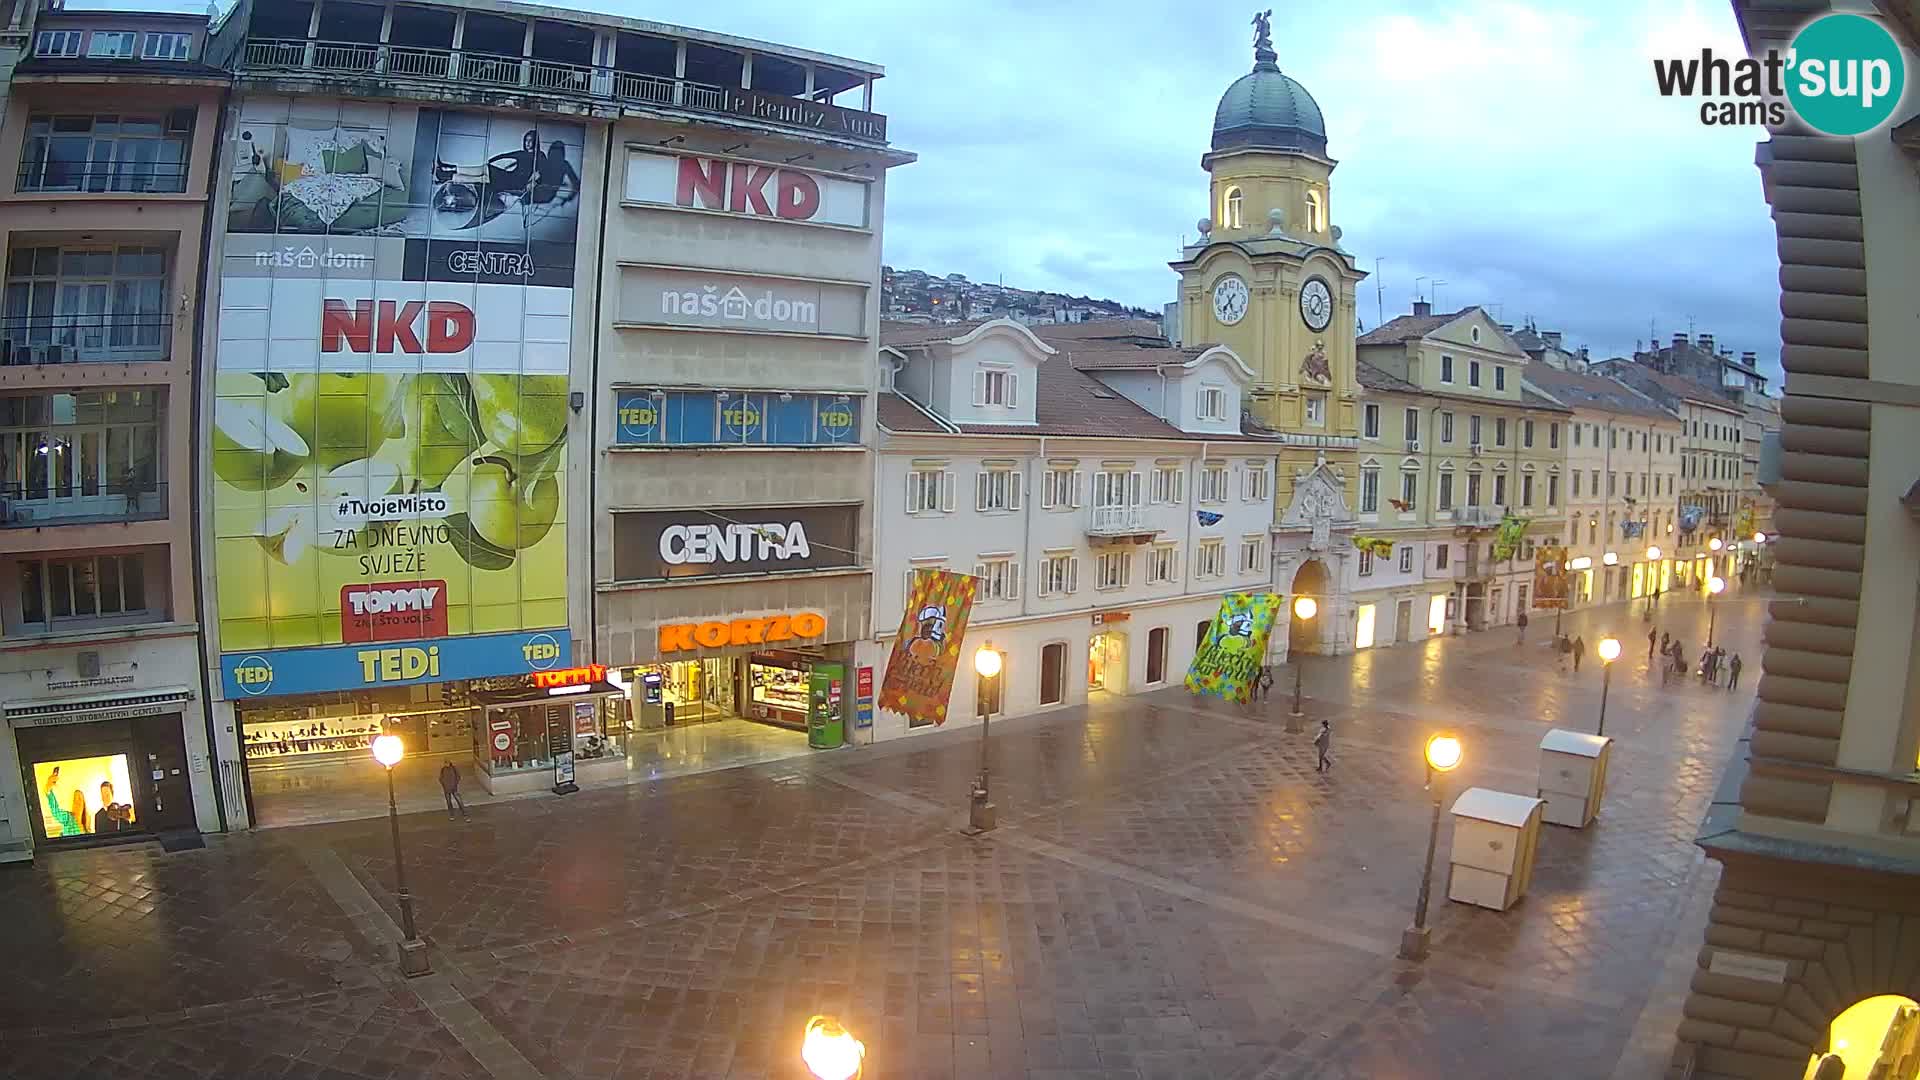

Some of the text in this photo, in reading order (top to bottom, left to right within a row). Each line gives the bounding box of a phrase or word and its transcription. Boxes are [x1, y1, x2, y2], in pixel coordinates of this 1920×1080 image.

[723, 89, 745, 112] Le
[752, 95, 825, 127] Rendez
[675, 157, 820, 220] NKD
[255, 247, 366, 269] naš dom
[448, 250, 535, 276] CENTRA
[661, 284, 816, 323] naš dom
[320, 297, 477, 354] NKD
[618, 407, 658, 428] TEDi
[722, 409, 760, 427] TEDi
[819, 411, 853, 428] TEDi
[338, 497, 446, 517] #TvojeMisto
[334, 524, 450, 549] ZA DNEVNO
[659, 521, 811, 565] CENTRA
[359, 548, 427, 576] SVJEŽE
[348, 587, 440, 616] TOMMY
[380, 614, 399, 625] ŠTO
[658, 612, 826, 653] KORZO
[358, 645, 440, 683] TEDi
[522, 644, 561, 661] TEDi
[80, 675, 134, 687] INFORMATION
[234, 667, 273, 684] TEDi
[533, 663, 607, 688] TOMMY
[132, 706, 163, 716] CENTAR
